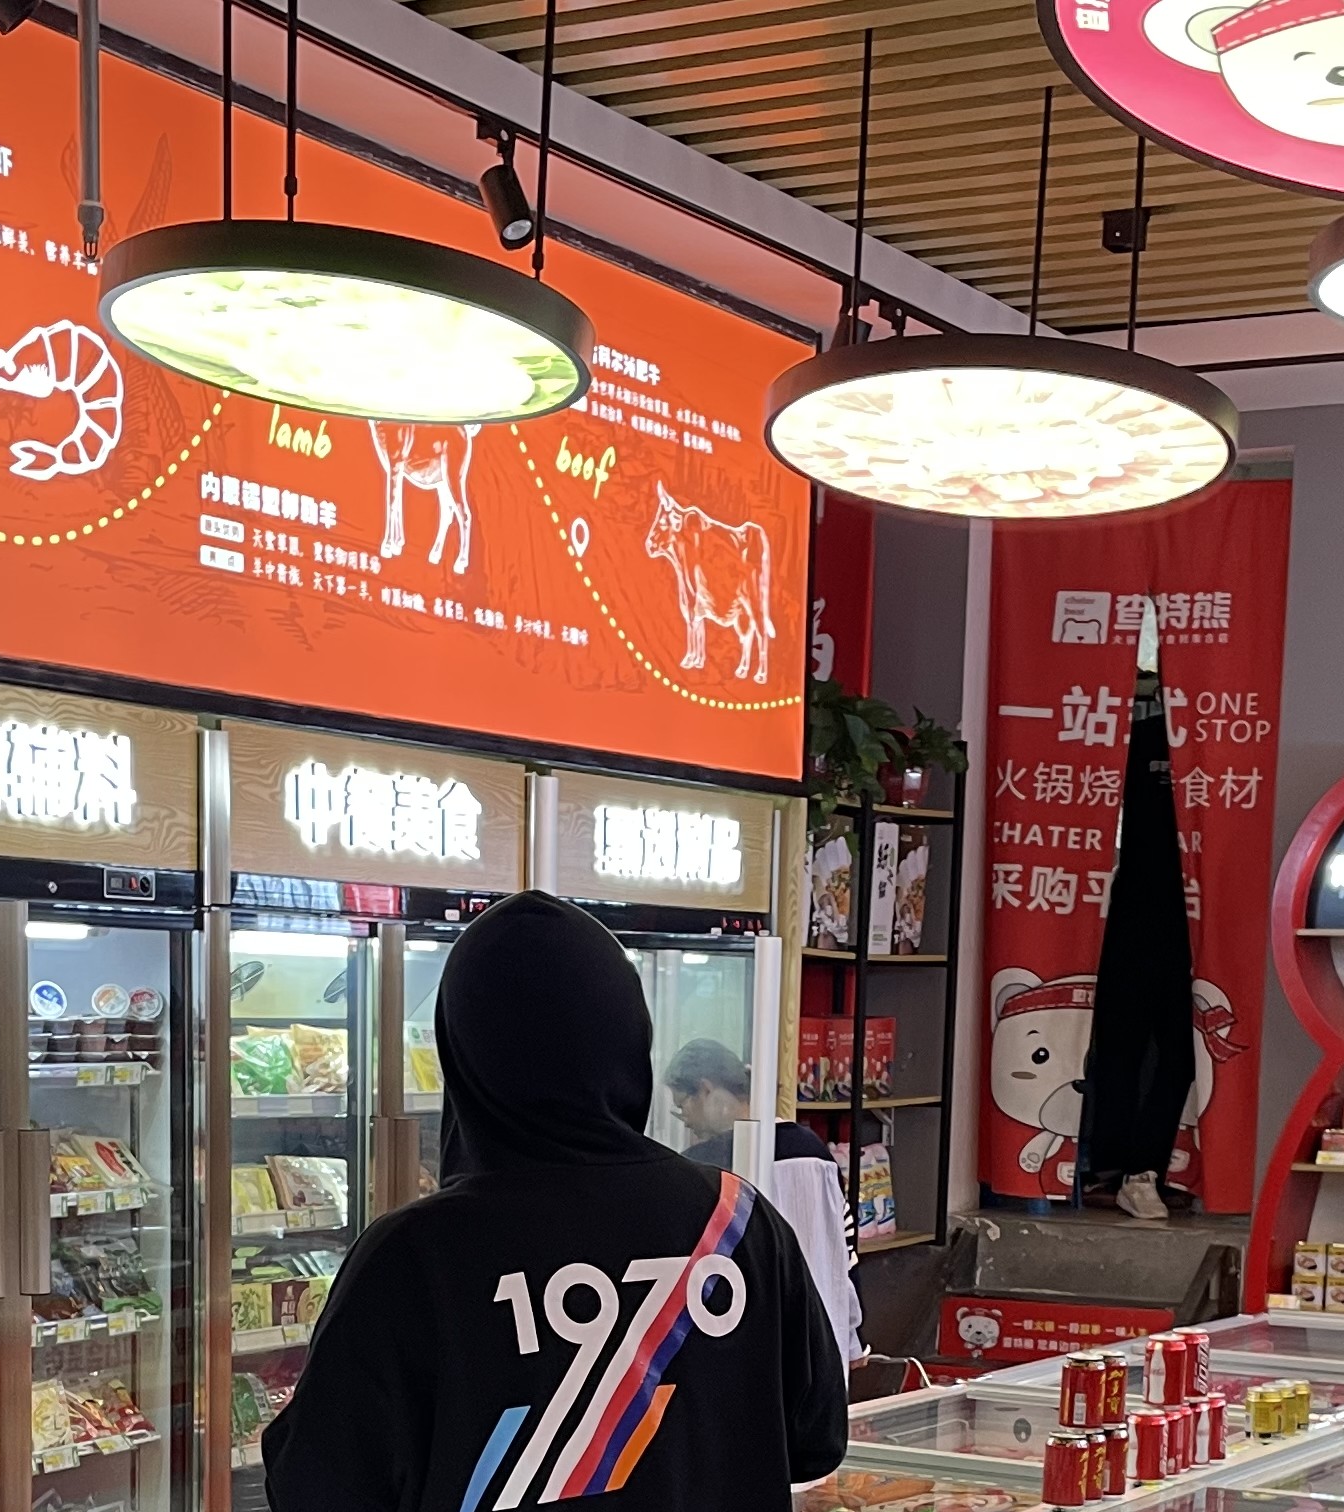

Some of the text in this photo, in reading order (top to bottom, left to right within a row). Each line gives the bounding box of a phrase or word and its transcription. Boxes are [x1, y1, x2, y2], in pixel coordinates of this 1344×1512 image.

[268, 404, 332, 460] lamb
[1114, 591, 1232, 630] 查特熊
[1196, 691, 1259, 715] ONE
[1195, 719, 1271, 742] STOP
[995, 759, 1263, 809] 火锅烧食材
